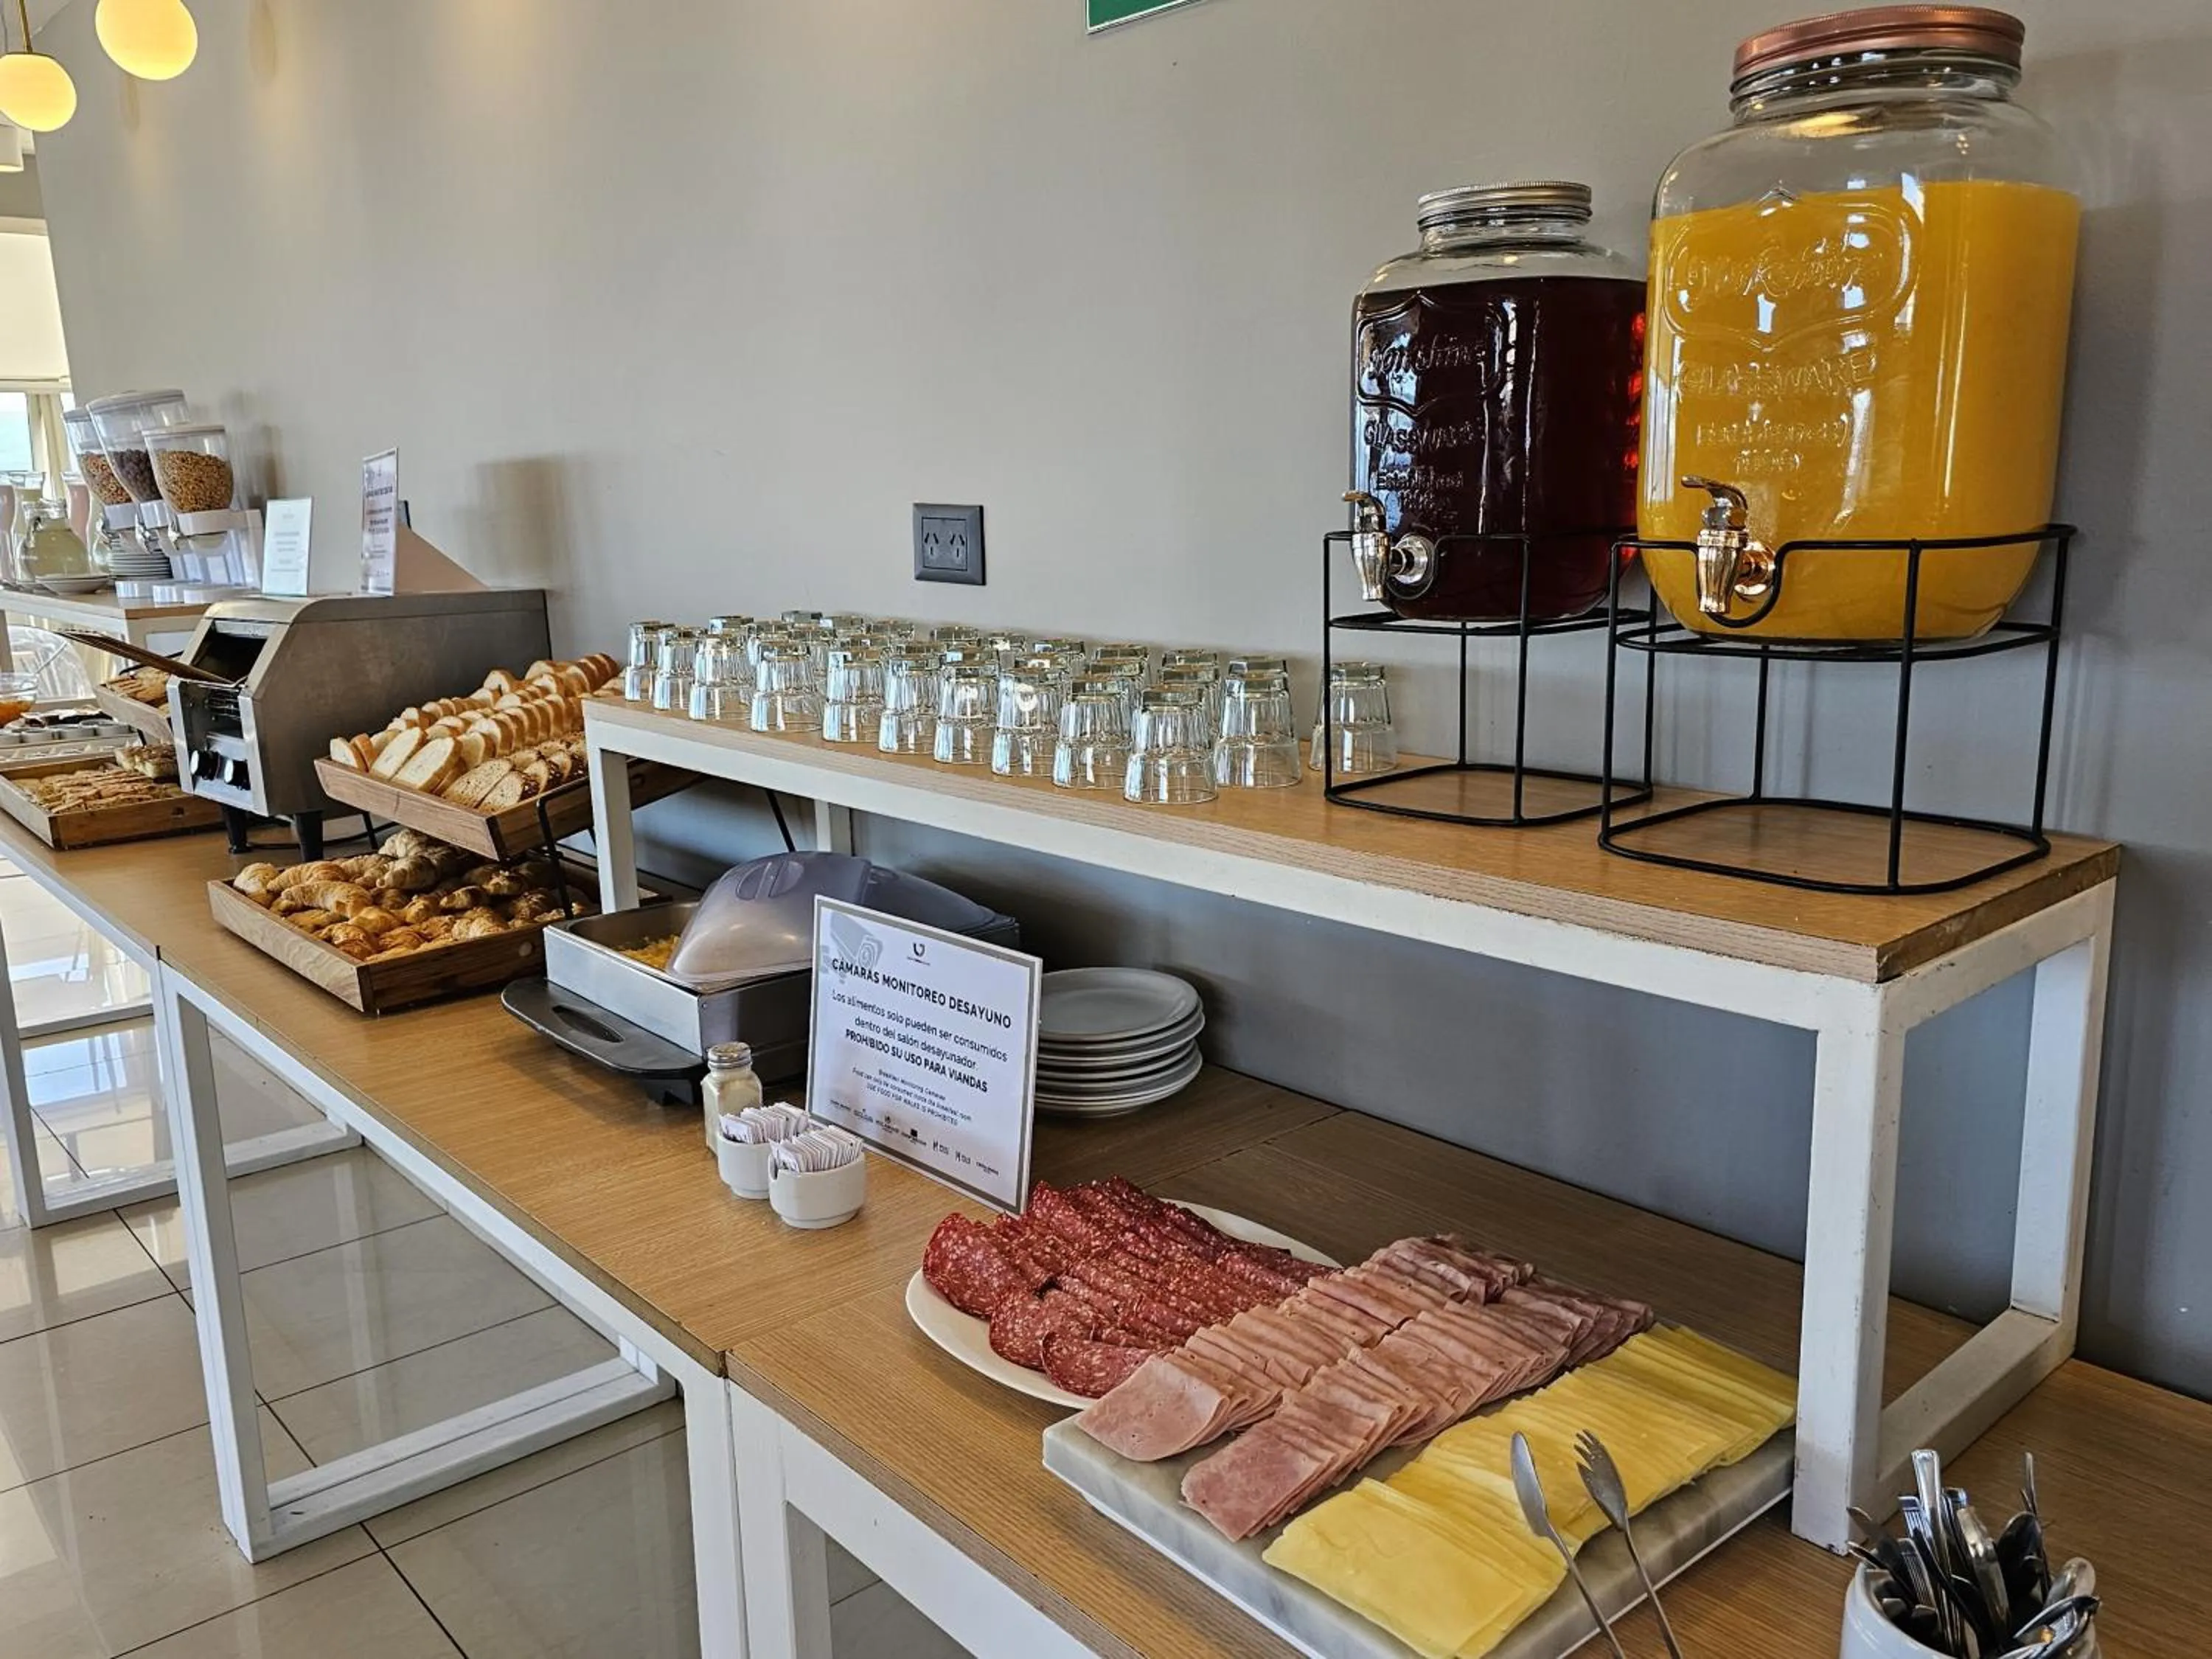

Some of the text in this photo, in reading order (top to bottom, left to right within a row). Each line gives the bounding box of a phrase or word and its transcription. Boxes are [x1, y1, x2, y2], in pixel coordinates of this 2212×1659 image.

[832, 989, 1009, 1062] Los alimentos solo pueden ser consumidos
[882, 973, 946, 1006] MONITOREO
[949, 995, 1011, 1029] DESAYUNO
[846, 1029, 988, 1093] PROHIBIDO SU USO PARA VIANDAS
[855, 1016, 881, 1034] dentro
[883, 1026, 896, 1040] del
[897, 1032, 919, 1048] salón
